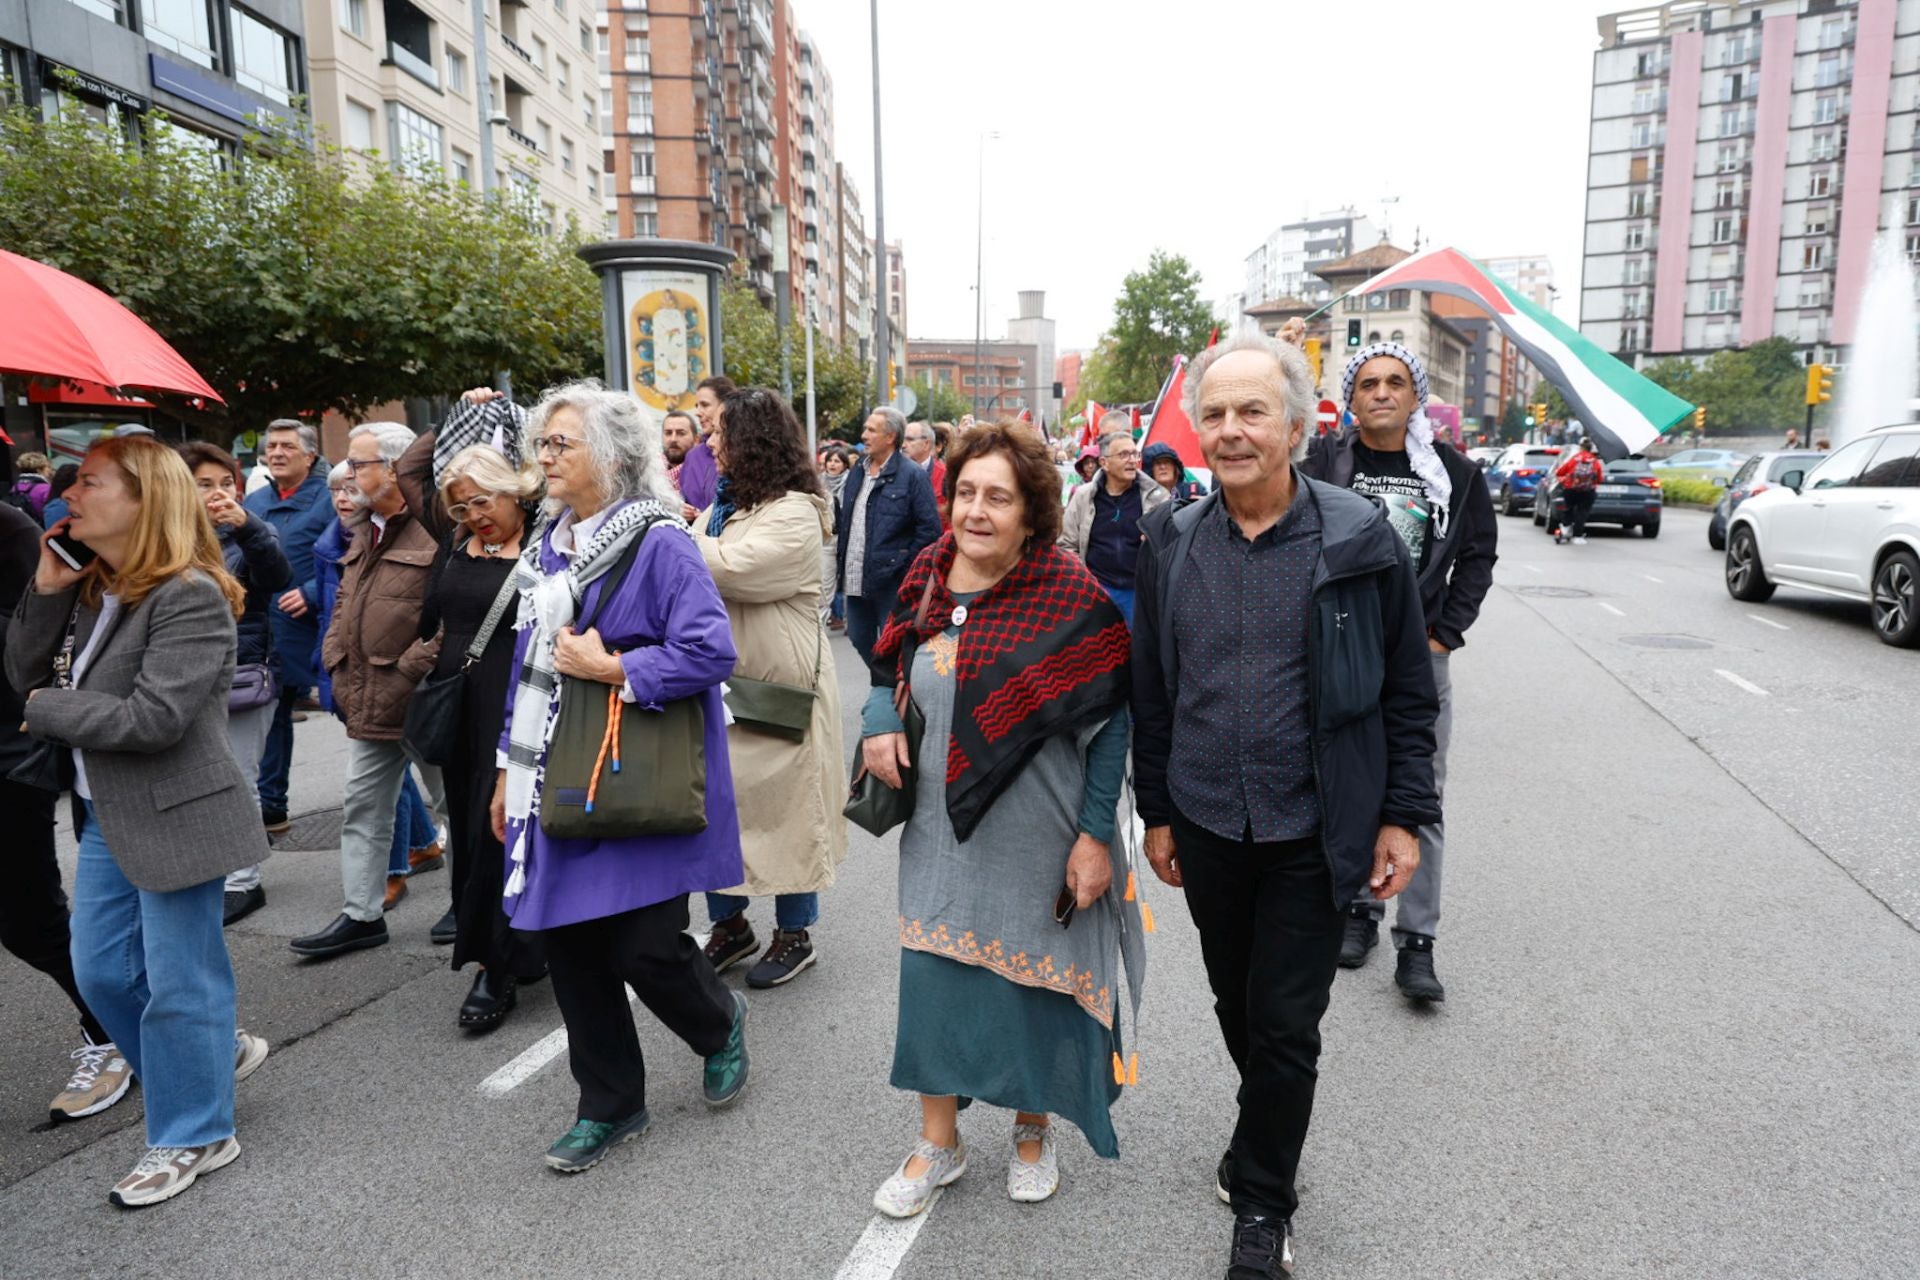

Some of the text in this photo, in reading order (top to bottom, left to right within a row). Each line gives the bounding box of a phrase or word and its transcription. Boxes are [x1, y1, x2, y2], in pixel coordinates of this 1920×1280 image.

[88, 82, 101, 94] con
[1354, 472, 1382, 484] SILENT
[1352, 481, 1422, 497] FOR PALESTINE
